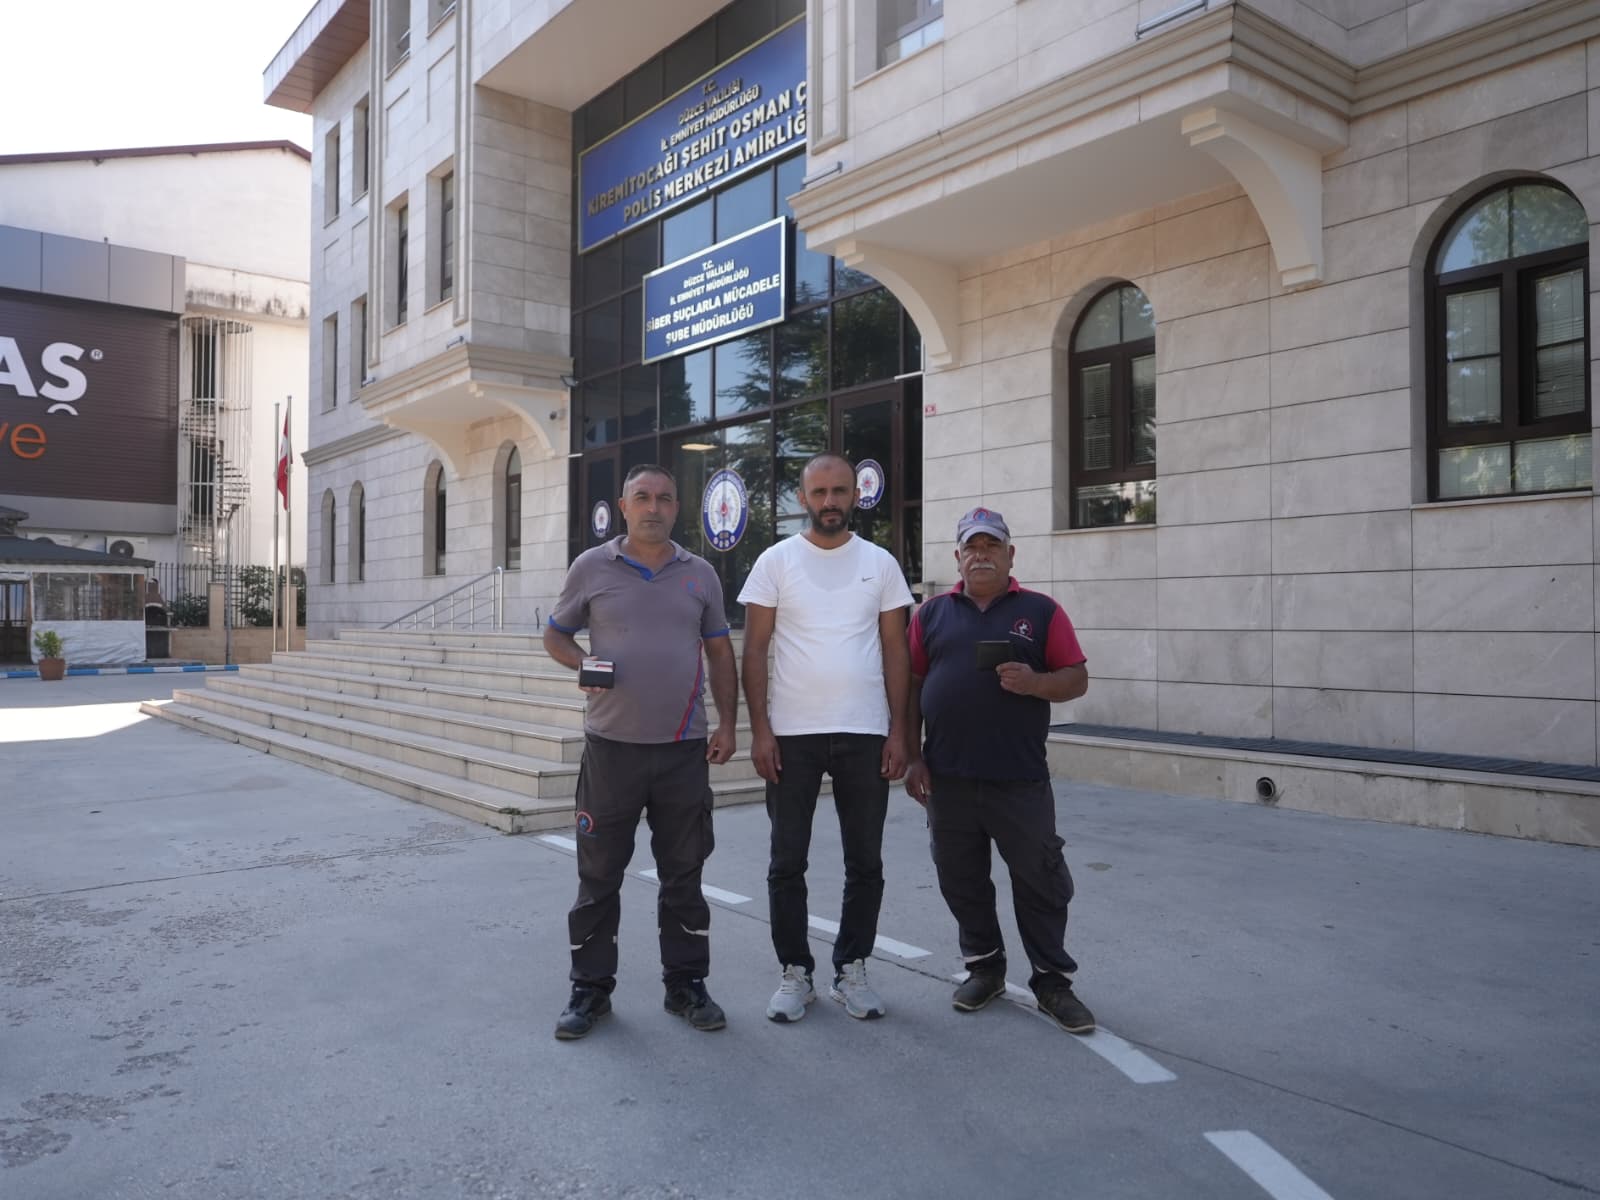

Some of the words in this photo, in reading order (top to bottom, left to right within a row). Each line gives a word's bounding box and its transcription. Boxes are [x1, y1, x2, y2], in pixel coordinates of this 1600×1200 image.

[670, 118, 705, 146] EMNİYET
[705, 84, 760, 126] MÜDÜRLÜĞÜ
[586, 152, 679, 217] KİREMİTOCAĞI
[681, 126, 726, 168] ŞEHİT
[730, 89, 790, 139] OSMAN
[623, 188, 662, 223] POLİS
[664, 149, 729, 201] MERKEZİ
[646, 315, 672, 332] SİBER
[673, 295, 721, 321] SUÇLARLA
[723, 273, 780, 305] MÜCADELE
[677, 286, 705, 303] EMNİYET
[706, 266, 750, 292] MÜDÜRLÜĞÜ
[683, 273, 705, 289] DÜZCE
[665, 328, 690, 346] ŞUBE
[691, 302, 754, 336] MÜDÜRLÜĞÜ
